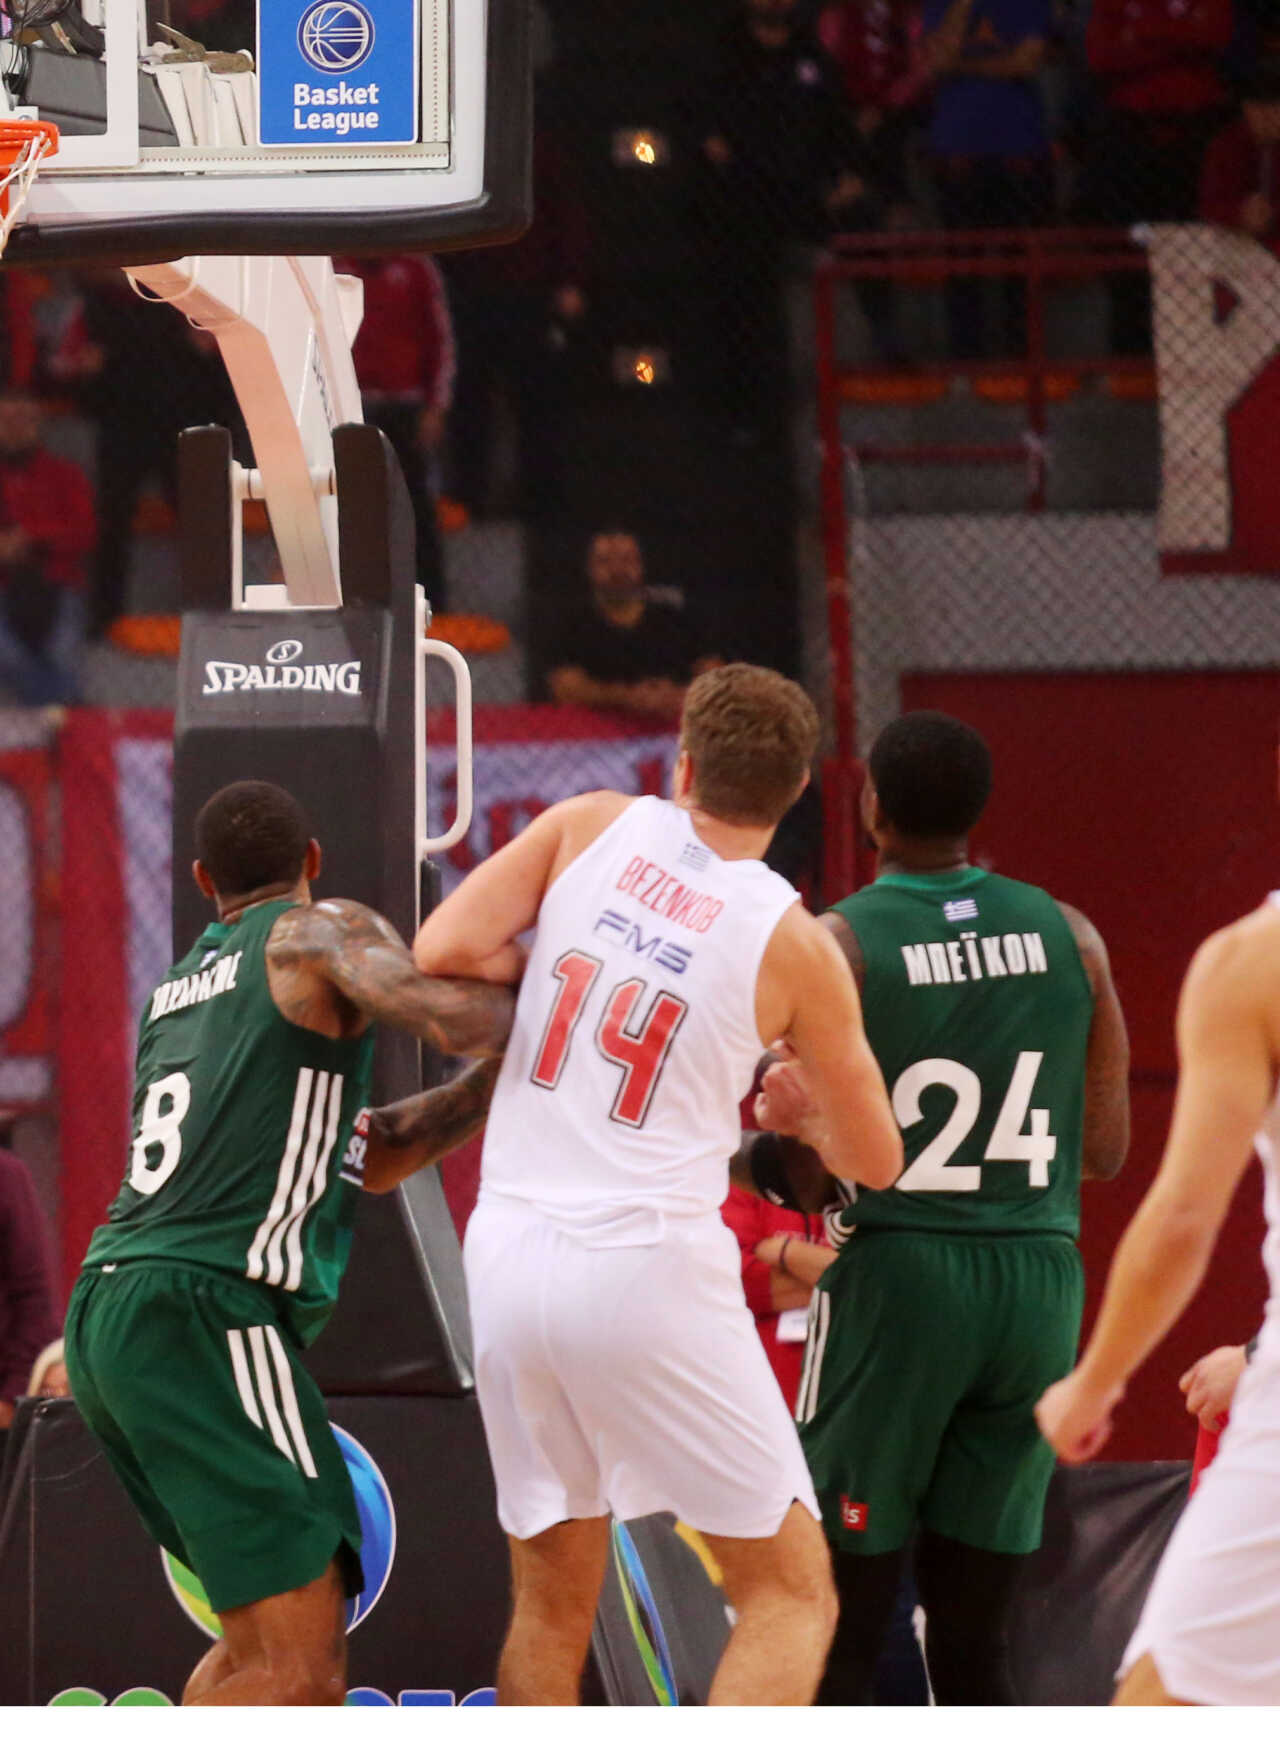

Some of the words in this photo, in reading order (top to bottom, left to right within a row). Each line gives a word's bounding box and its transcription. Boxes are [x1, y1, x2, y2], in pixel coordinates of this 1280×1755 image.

[293, 81, 380, 106] Basket
[293, 108, 380, 135] League
[202, 660, 363, 695] SPALDING
[593, 909, 694, 975] FMS
[530, 948, 689, 1130] 14
[128, 1071, 192, 1195] 8
[891, 1050, 1058, 1192] 24
